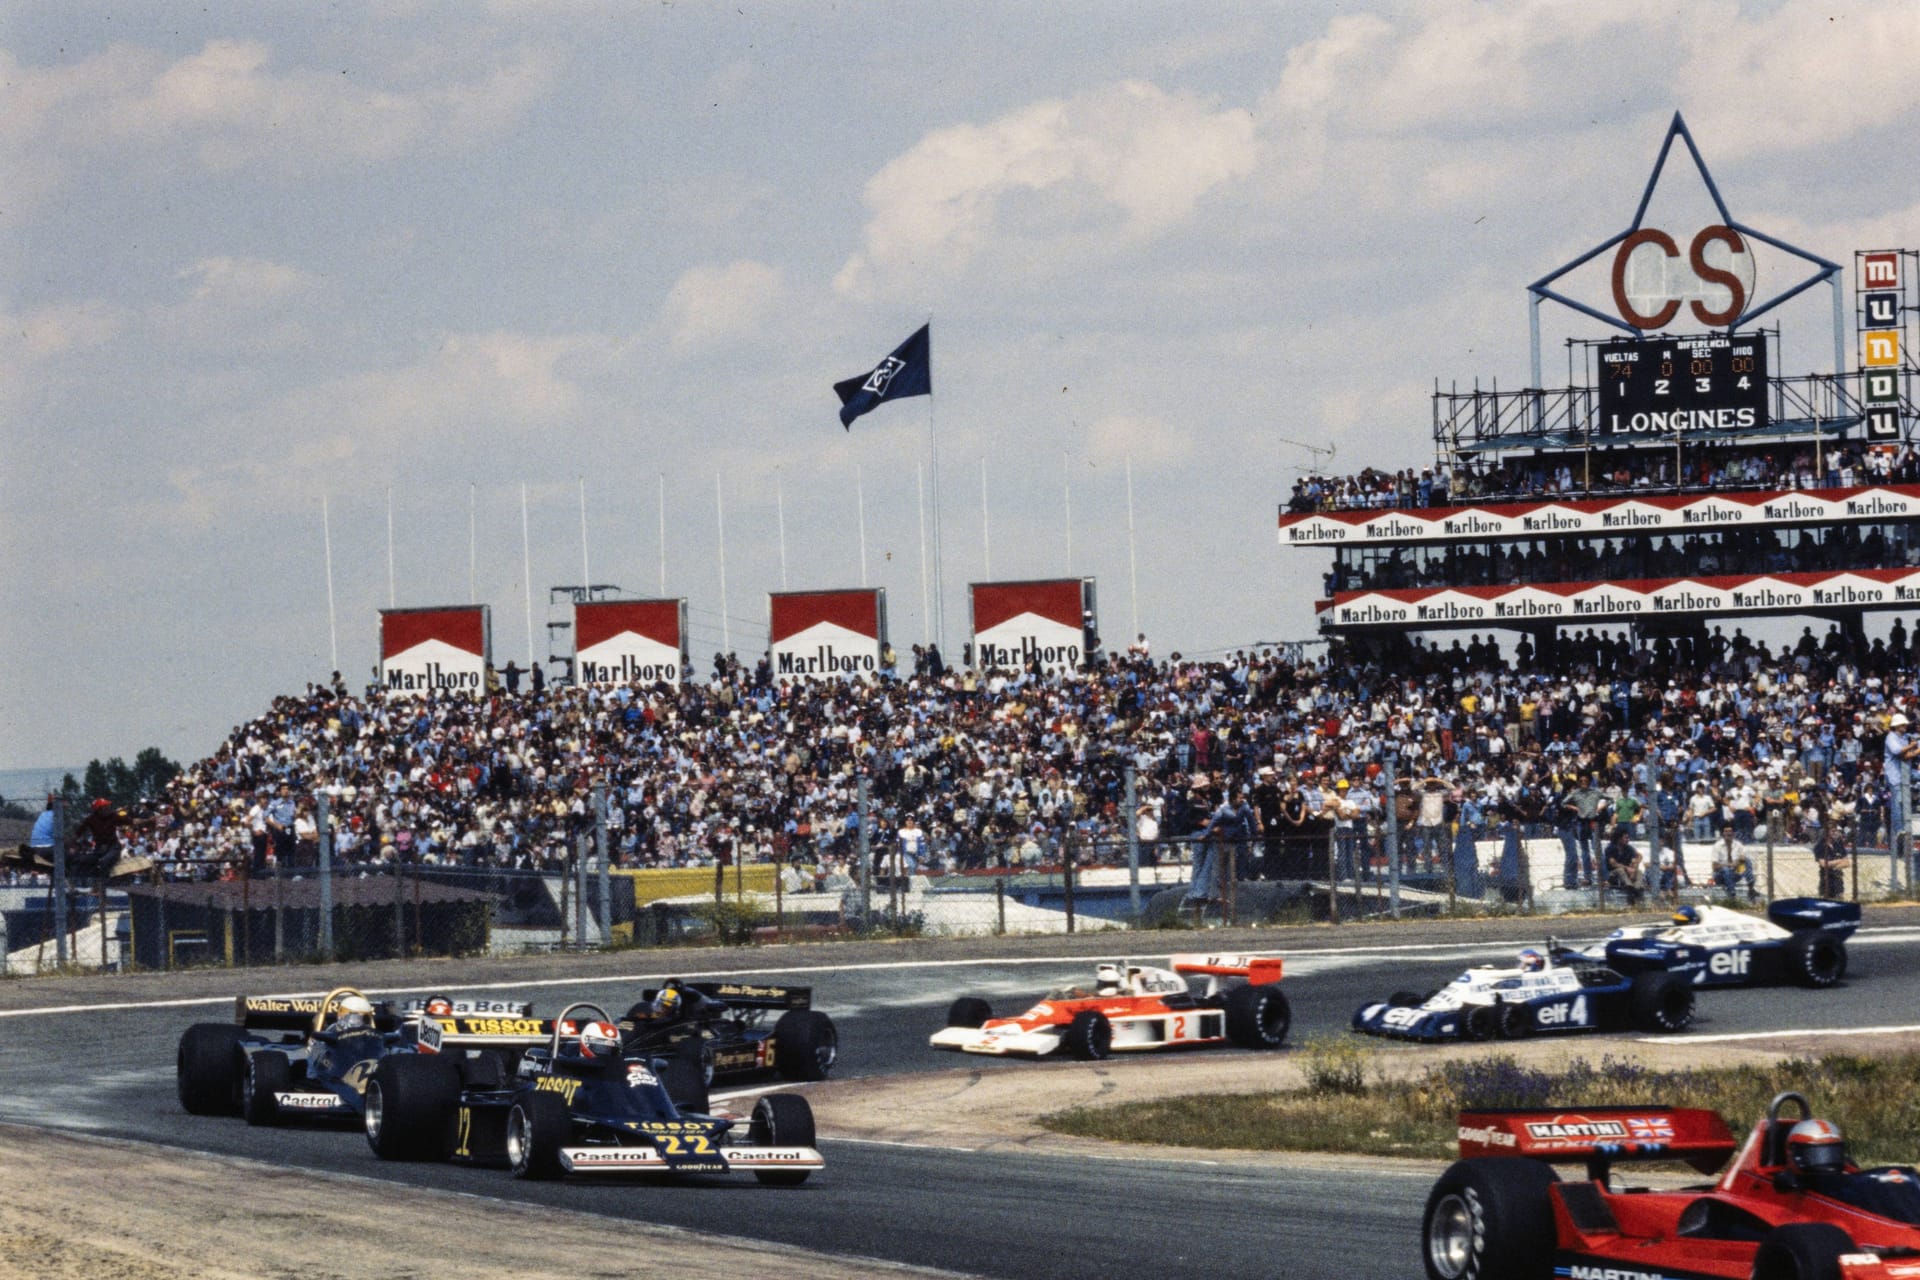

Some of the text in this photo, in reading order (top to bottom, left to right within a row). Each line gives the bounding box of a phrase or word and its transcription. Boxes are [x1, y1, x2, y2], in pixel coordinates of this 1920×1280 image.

[1611, 225, 1745, 330] CS
[1604, 352, 1639, 363] VUELTAS
[1692, 348, 1712, 358] SEC
[1620, 375, 1751, 396] 1 2 3 4
[1612, 407, 1756, 433] LONGINES
[1289, 497, 1907, 541] Marlboro Marlboro Marlboro Marlboro Marlboro Marlboro Marlboro Marlboro
[1341, 605, 1407, 622] Marlboro
[1417, 602, 1483, 620] Marlboro
[1495, 599, 1562, 617] Marlboro
[1573, 595, 1641, 614] Marlboro
[1653, 592, 1721, 610] Marlboro
[1732, 589, 1802, 607] Marlboro
[1813, 586, 1883, 604] Marlboro
[778, 645, 874, 674] Marlboro
[980, 636, 1078, 666] Marlboro
[387, 662, 480, 690] Marlboro
[581, 655, 676, 683] Marlboro
[1710, 949, 1751, 975] elf
[246, 999, 290, 1012] Walter
[1383, 1007, 1430, 1027] elf
[1537, 994, 1588, 1025] elf 4
[464, 1018, 543, 1032] TISSOT
[1174, 1016, 1185, 1039] 2
[280, 1094, 337, 1106] Castrol
[535, 1076, 582, 1106] TISSOT
[624, 1122, 715, 1130] TISSOT
[1531, 1123, 1622, 1138] MARTINI
[573, 1151, 648, 1161] Castrol
[655, 1135, 717, 1154] 22
[728, 1151, 801, 1160] Castrol
